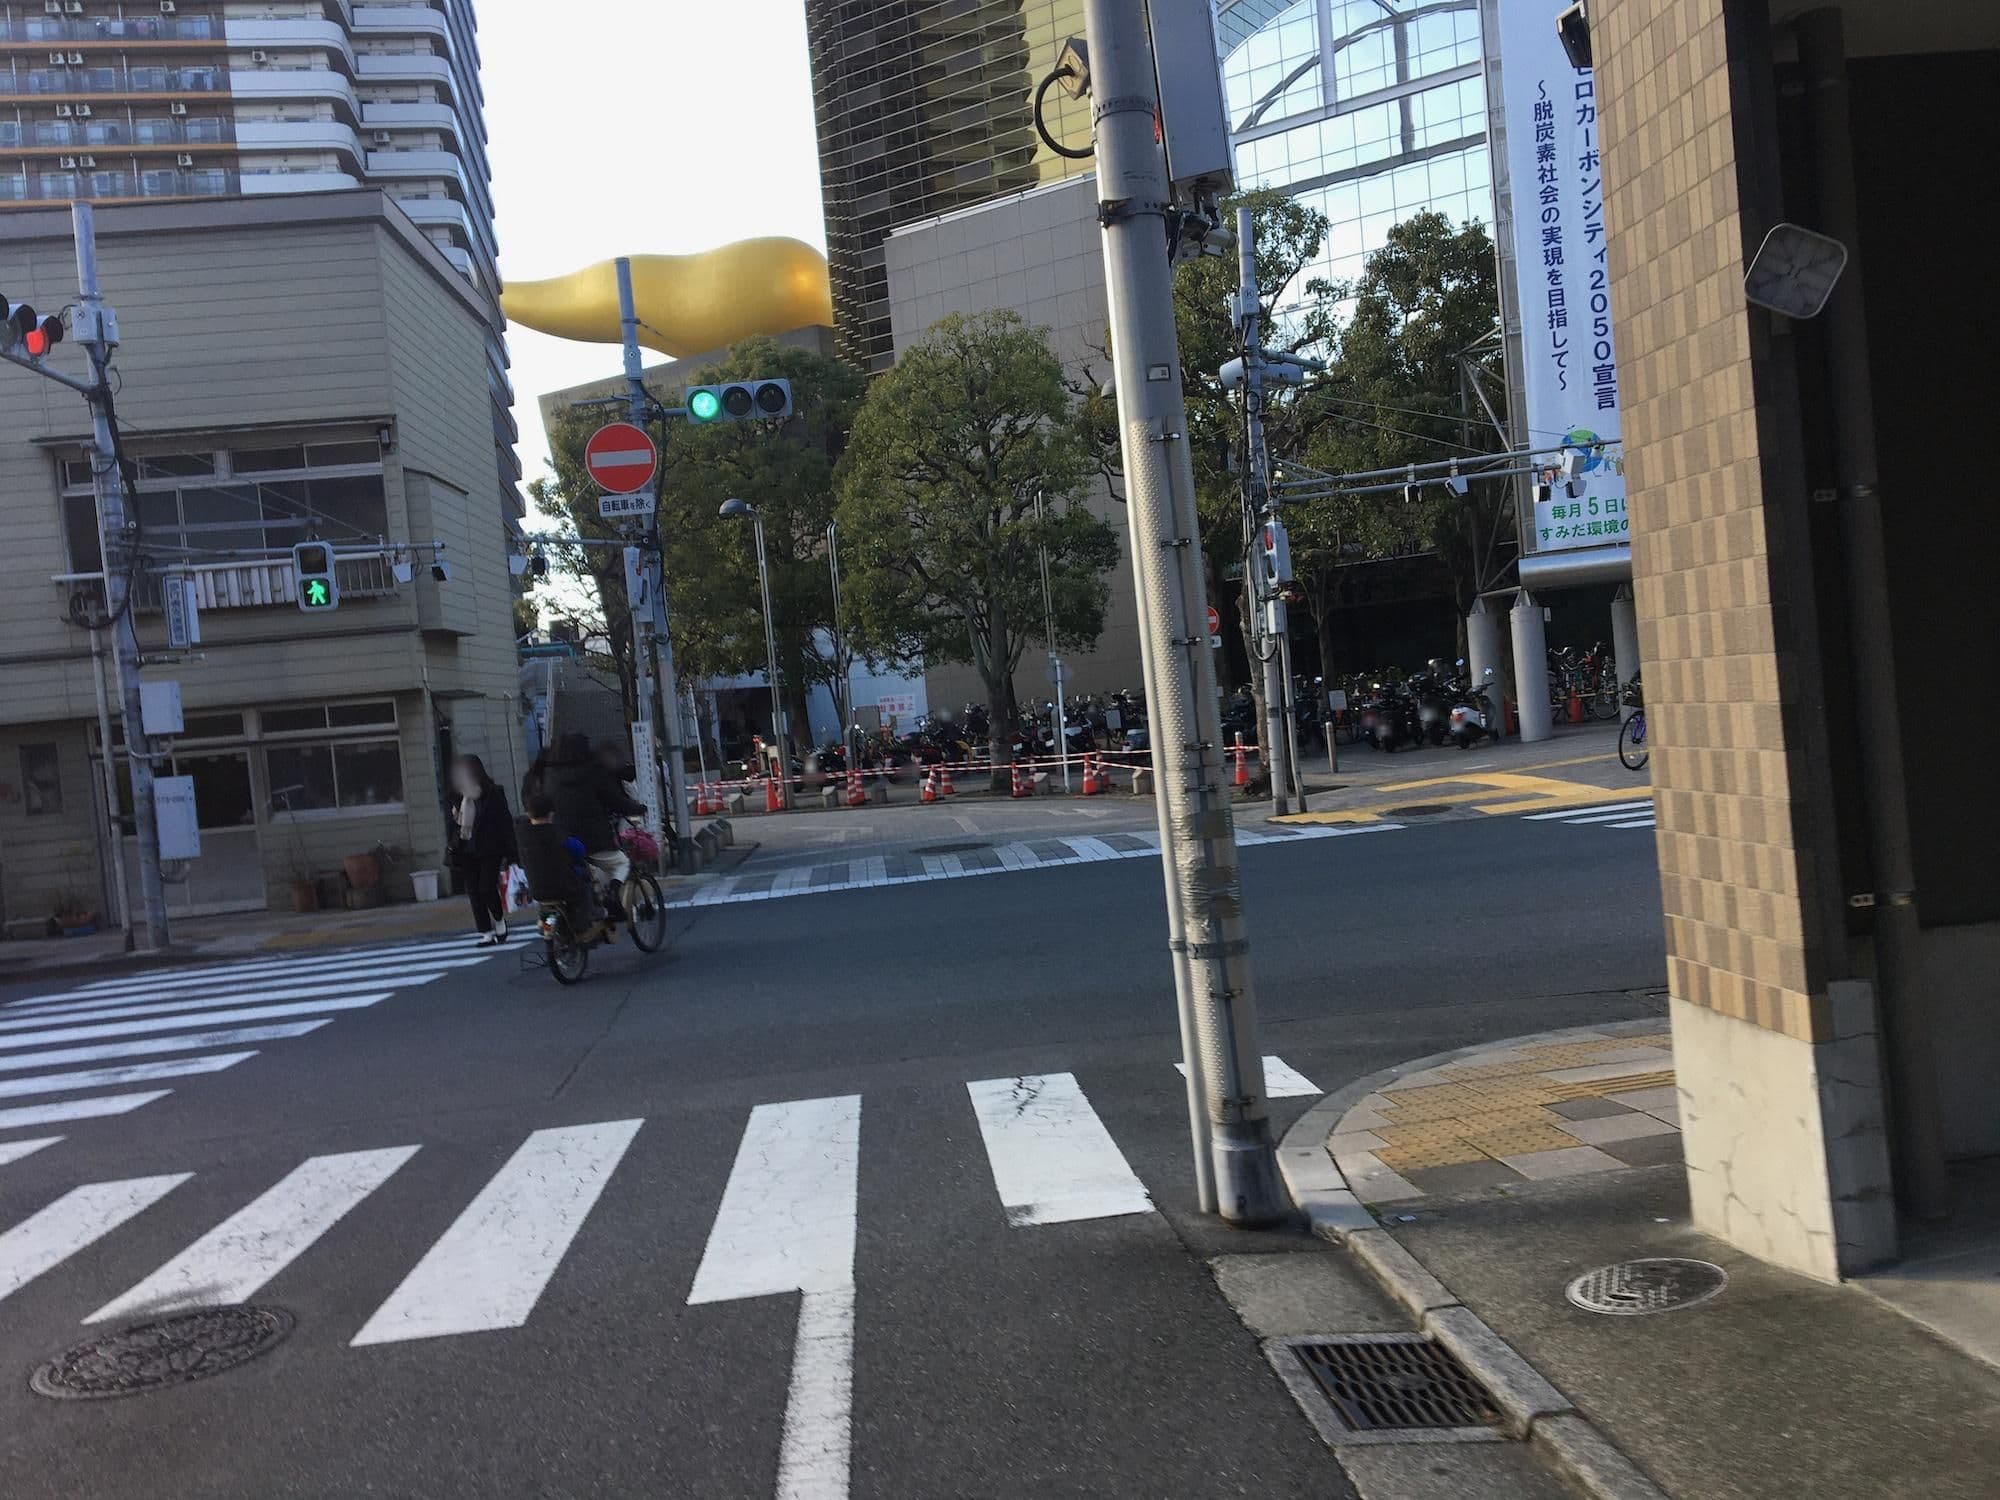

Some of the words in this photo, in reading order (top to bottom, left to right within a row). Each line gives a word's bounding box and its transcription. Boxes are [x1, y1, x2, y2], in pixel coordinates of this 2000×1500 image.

[602, 497, 652, 512] 自転車を除く
